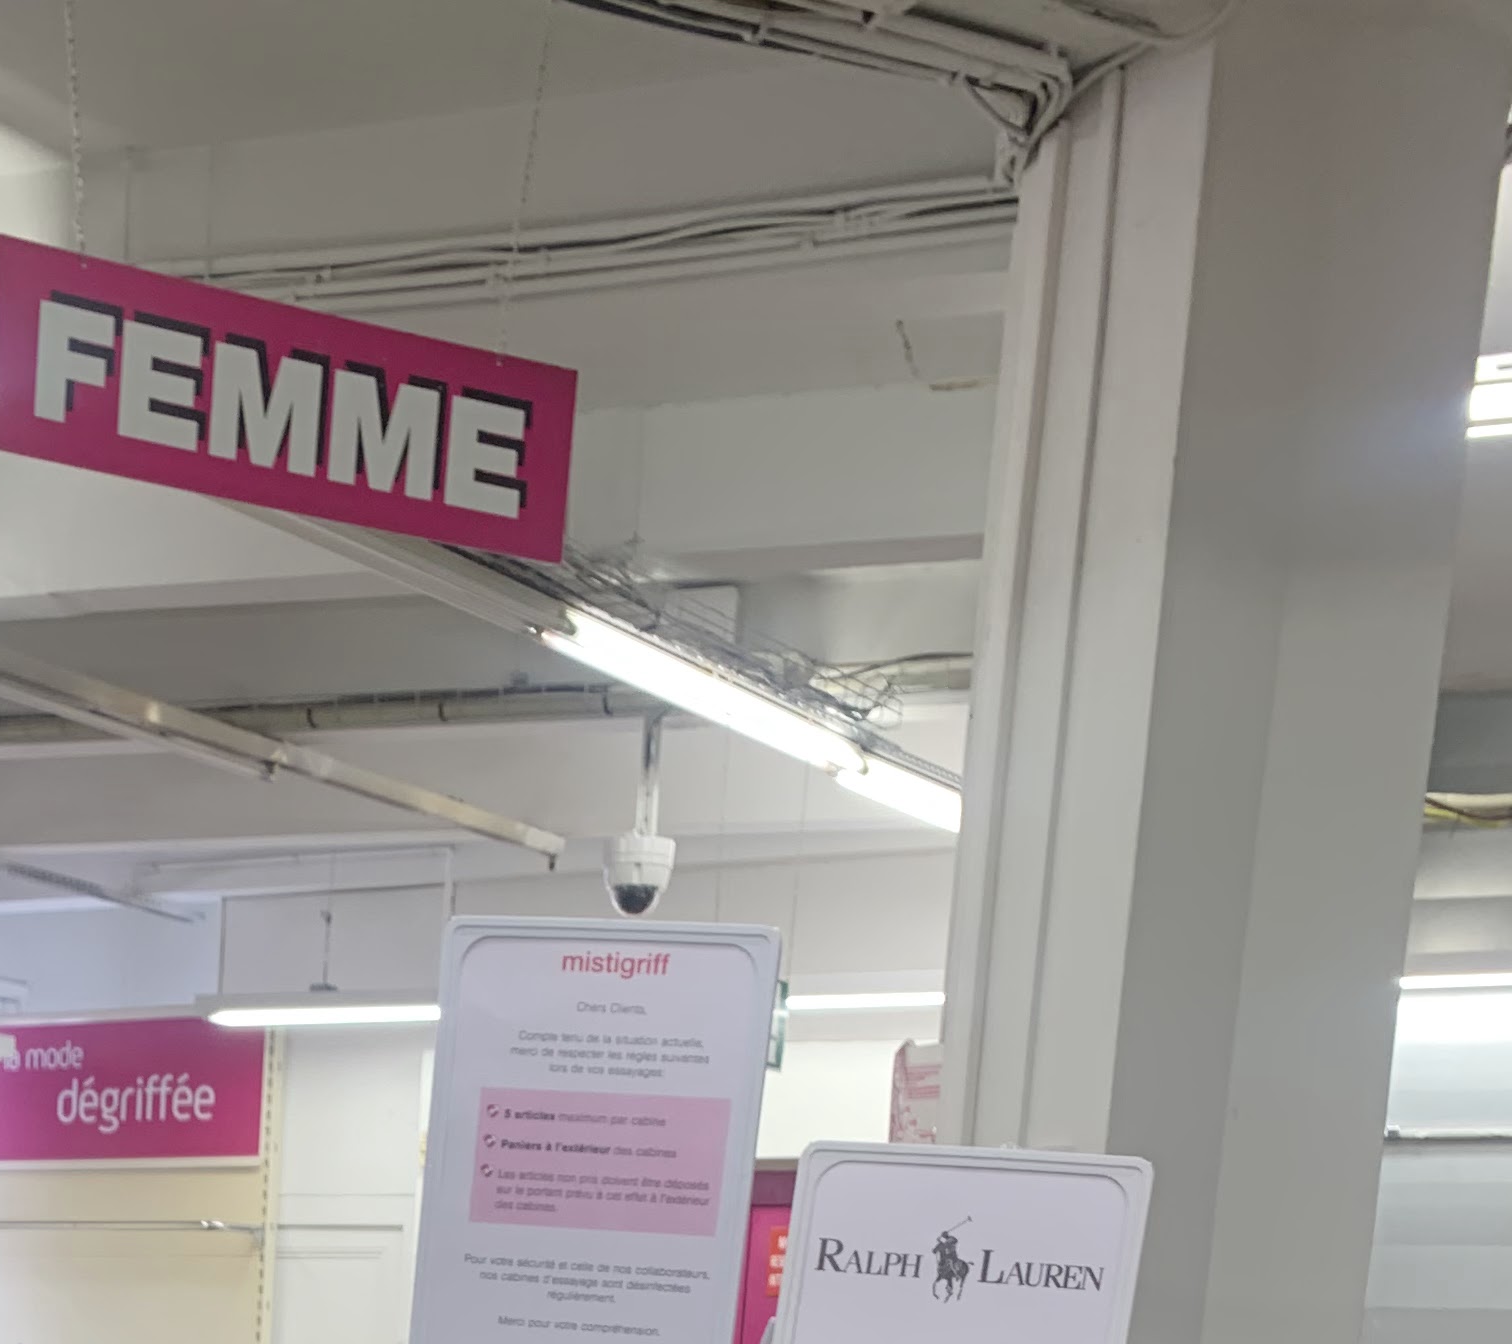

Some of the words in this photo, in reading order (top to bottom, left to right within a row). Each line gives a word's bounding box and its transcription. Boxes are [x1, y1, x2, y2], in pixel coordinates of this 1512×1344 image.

[34, 293, 531, 518] FEMME
[561, 951, 670, 979] mistigriff
[25, 1039, 84, 1070] mode
[57, 1073, 215, 1133] dégriffée
[514, 1110, 555, 1121] articles
[501, 1139, 542, 1151] Paniers
[814, 1237, 924, 1278] RALPH
[977, 1249, 1106, 1292] LAUREN
